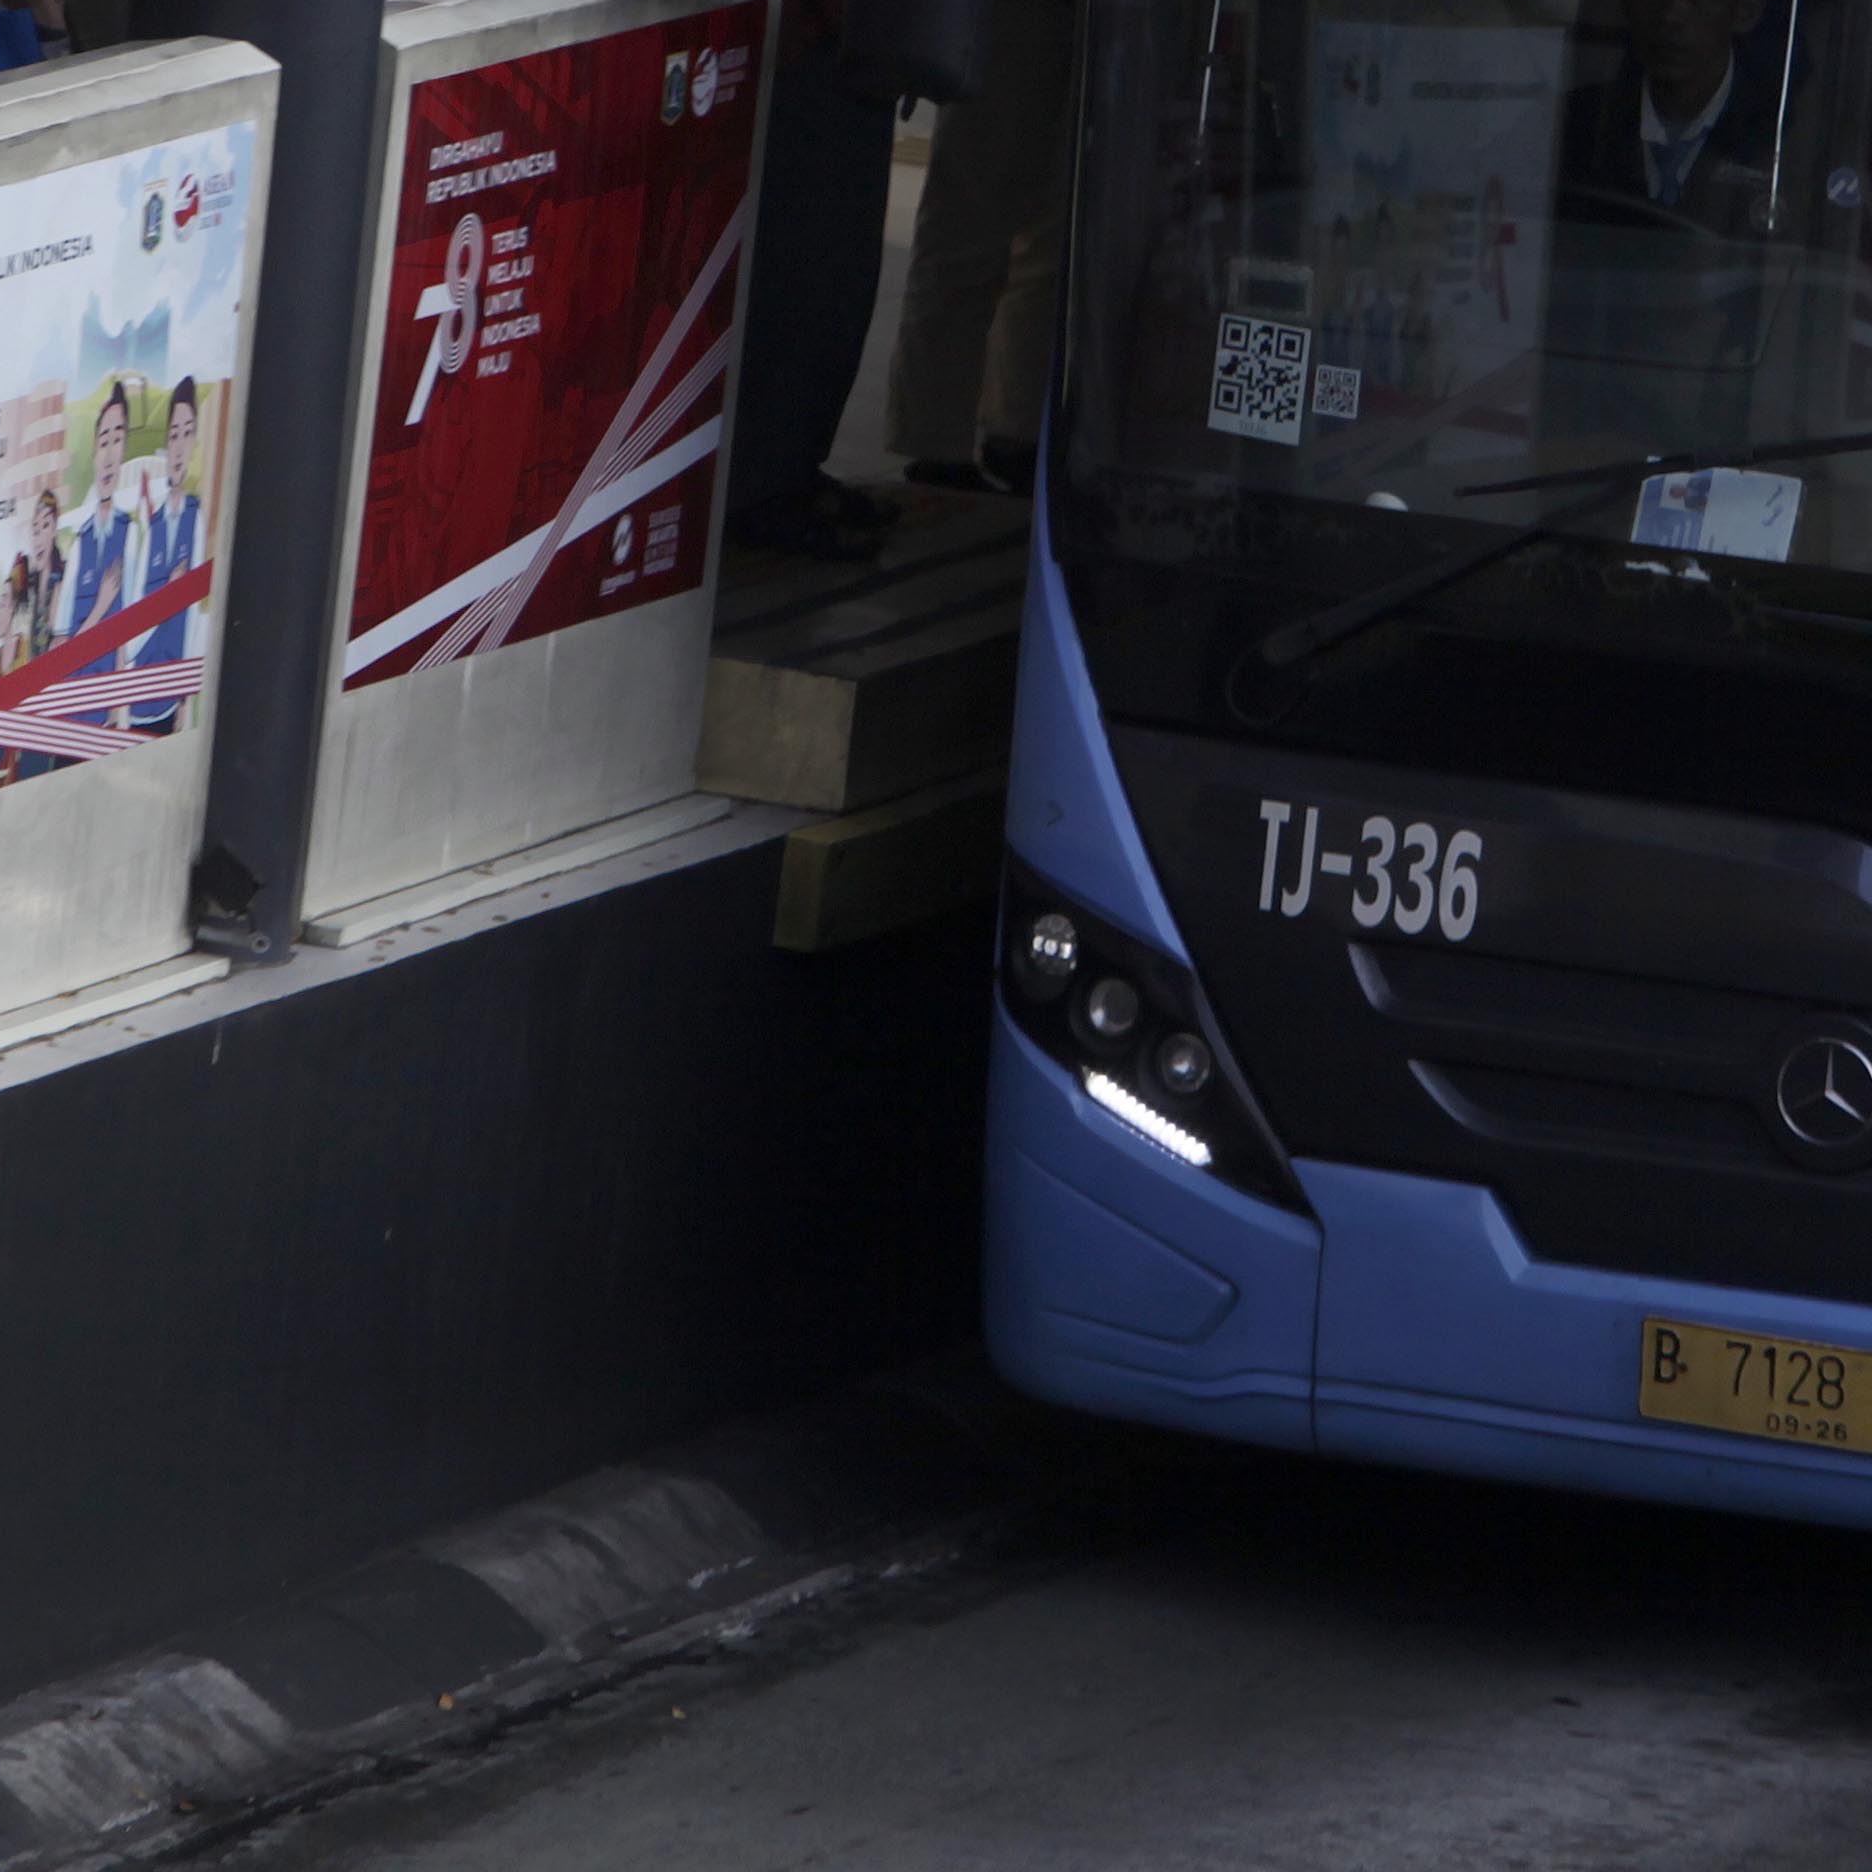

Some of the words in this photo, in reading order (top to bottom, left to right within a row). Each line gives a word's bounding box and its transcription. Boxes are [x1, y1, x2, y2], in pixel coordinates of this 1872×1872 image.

[21, 234, 95, 275] INDONESIA
[491, 226, 529, 255] TERUS
[486, 255, 535, 287] MELAJU
[483, 287, 525, 318] UNTUK
[480, 312, 542, 348] INDONESIA
[476, 350, 513, 379] MAJU
[1259, 799, 1483, 943] TJ-336
[1653, 1328, 1681, 1385] B
[1725, 1339, 1846, 1411] 7128
